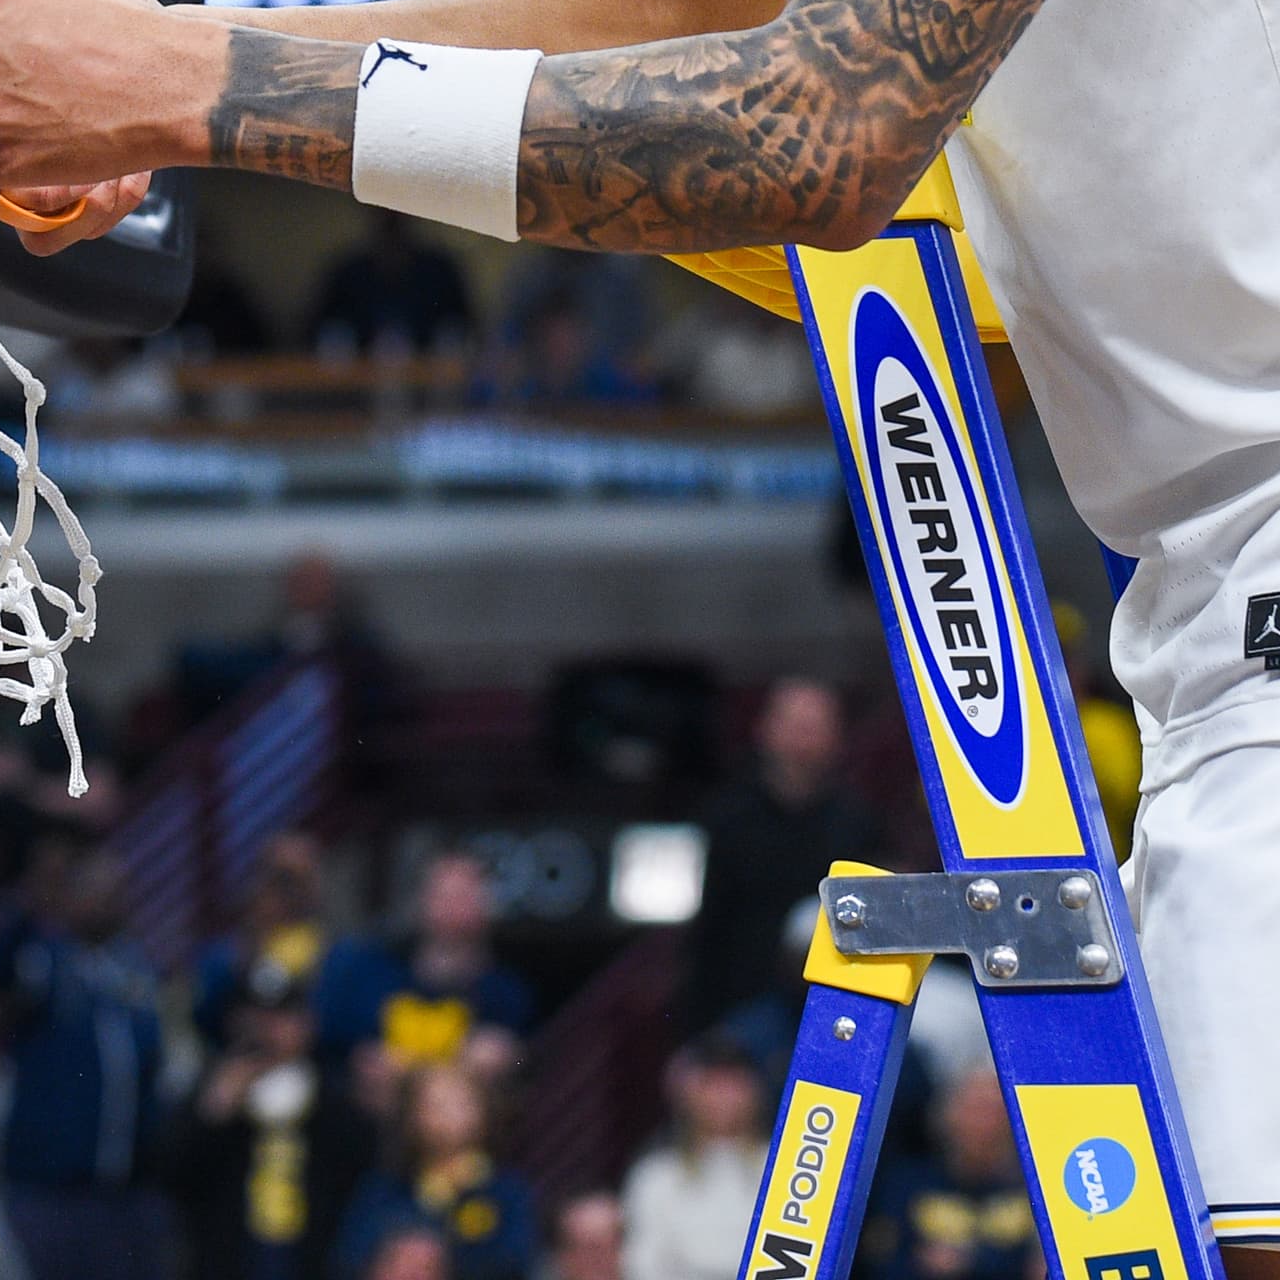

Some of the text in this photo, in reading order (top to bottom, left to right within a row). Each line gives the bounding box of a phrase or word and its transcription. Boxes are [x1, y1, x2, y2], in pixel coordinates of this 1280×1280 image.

[879, 392, 999, 702] WERNER
[782, 1105, 835, 1225] PODIO
[1075, 1149, 1110, 1213] NCAA
